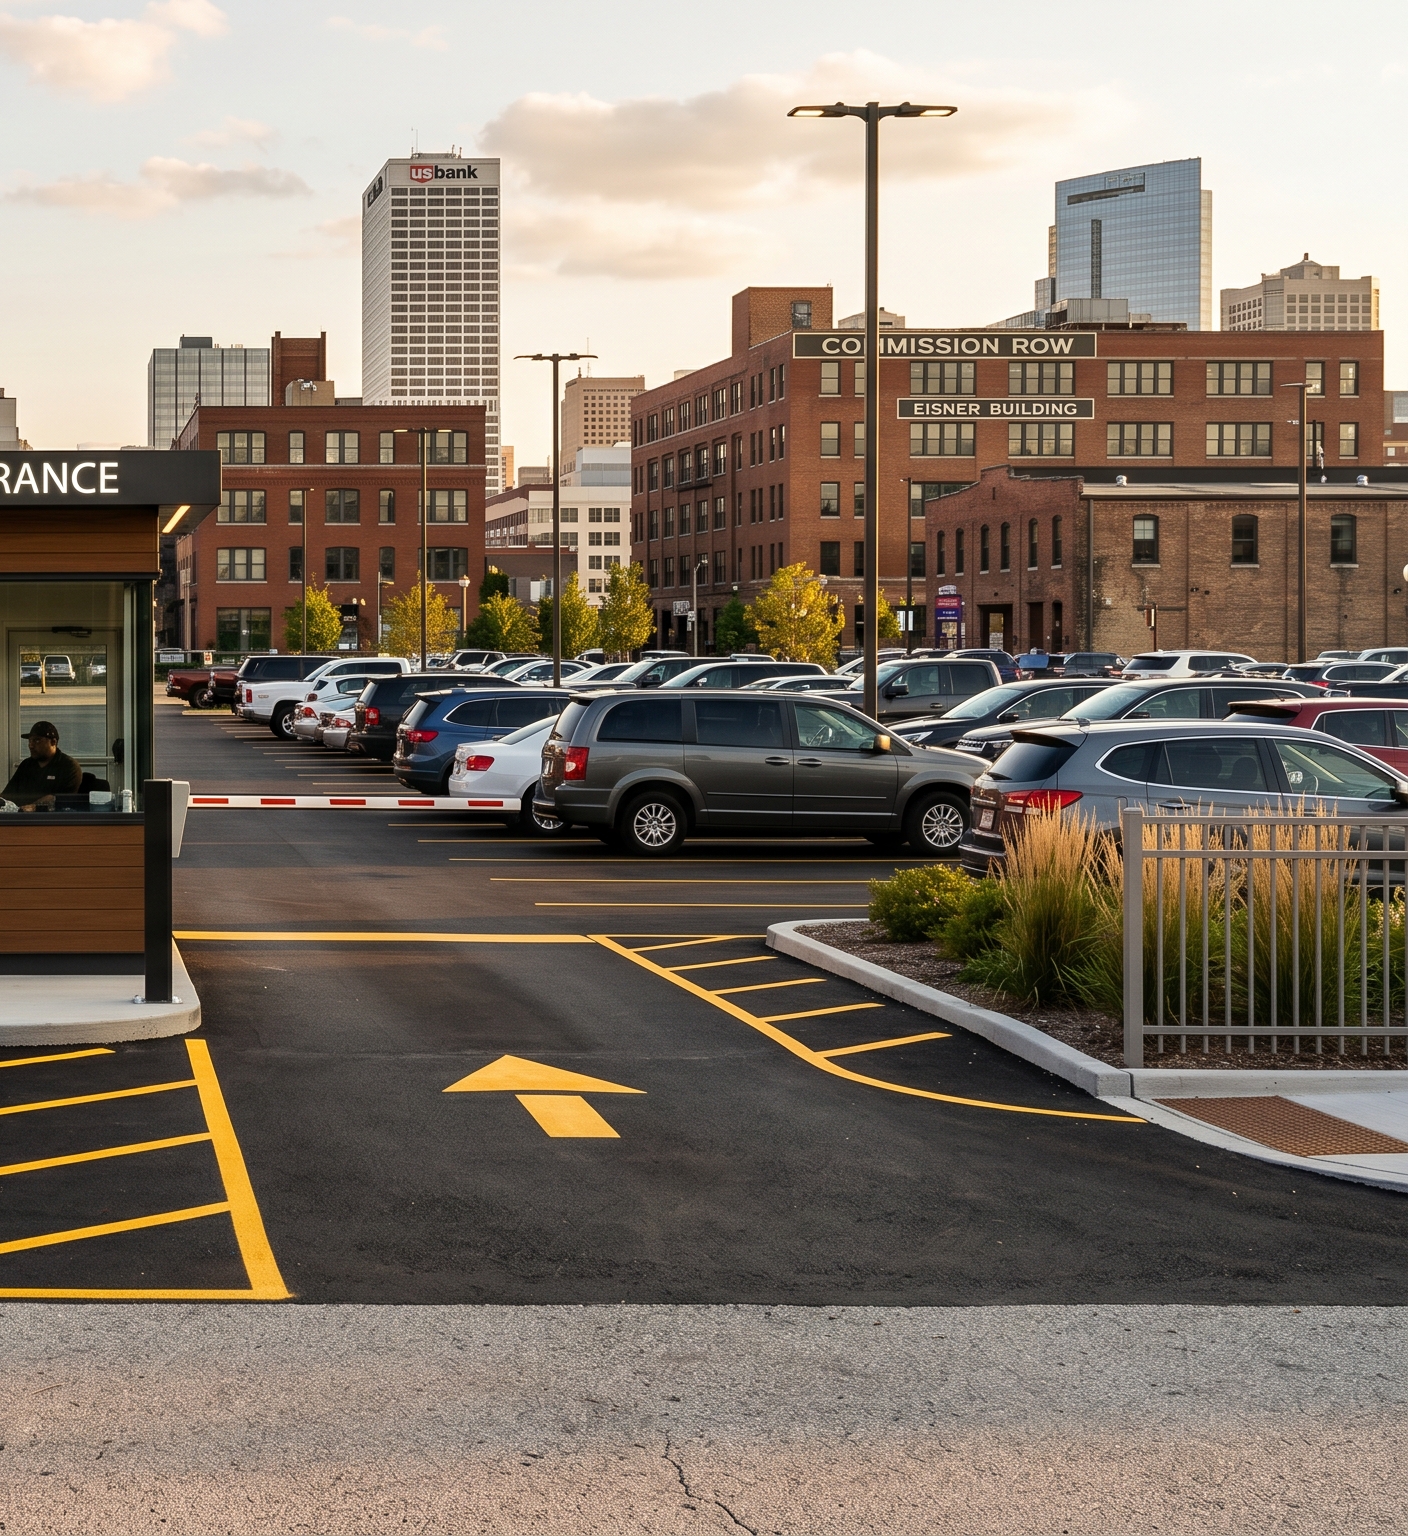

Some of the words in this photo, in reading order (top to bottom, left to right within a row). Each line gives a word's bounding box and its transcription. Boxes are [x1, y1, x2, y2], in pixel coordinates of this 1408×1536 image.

[1012, 337, 1075, 355] ROW
[913, 403, 980, 416] EISNER
[990, 403, 1078, 416] BUILDING
